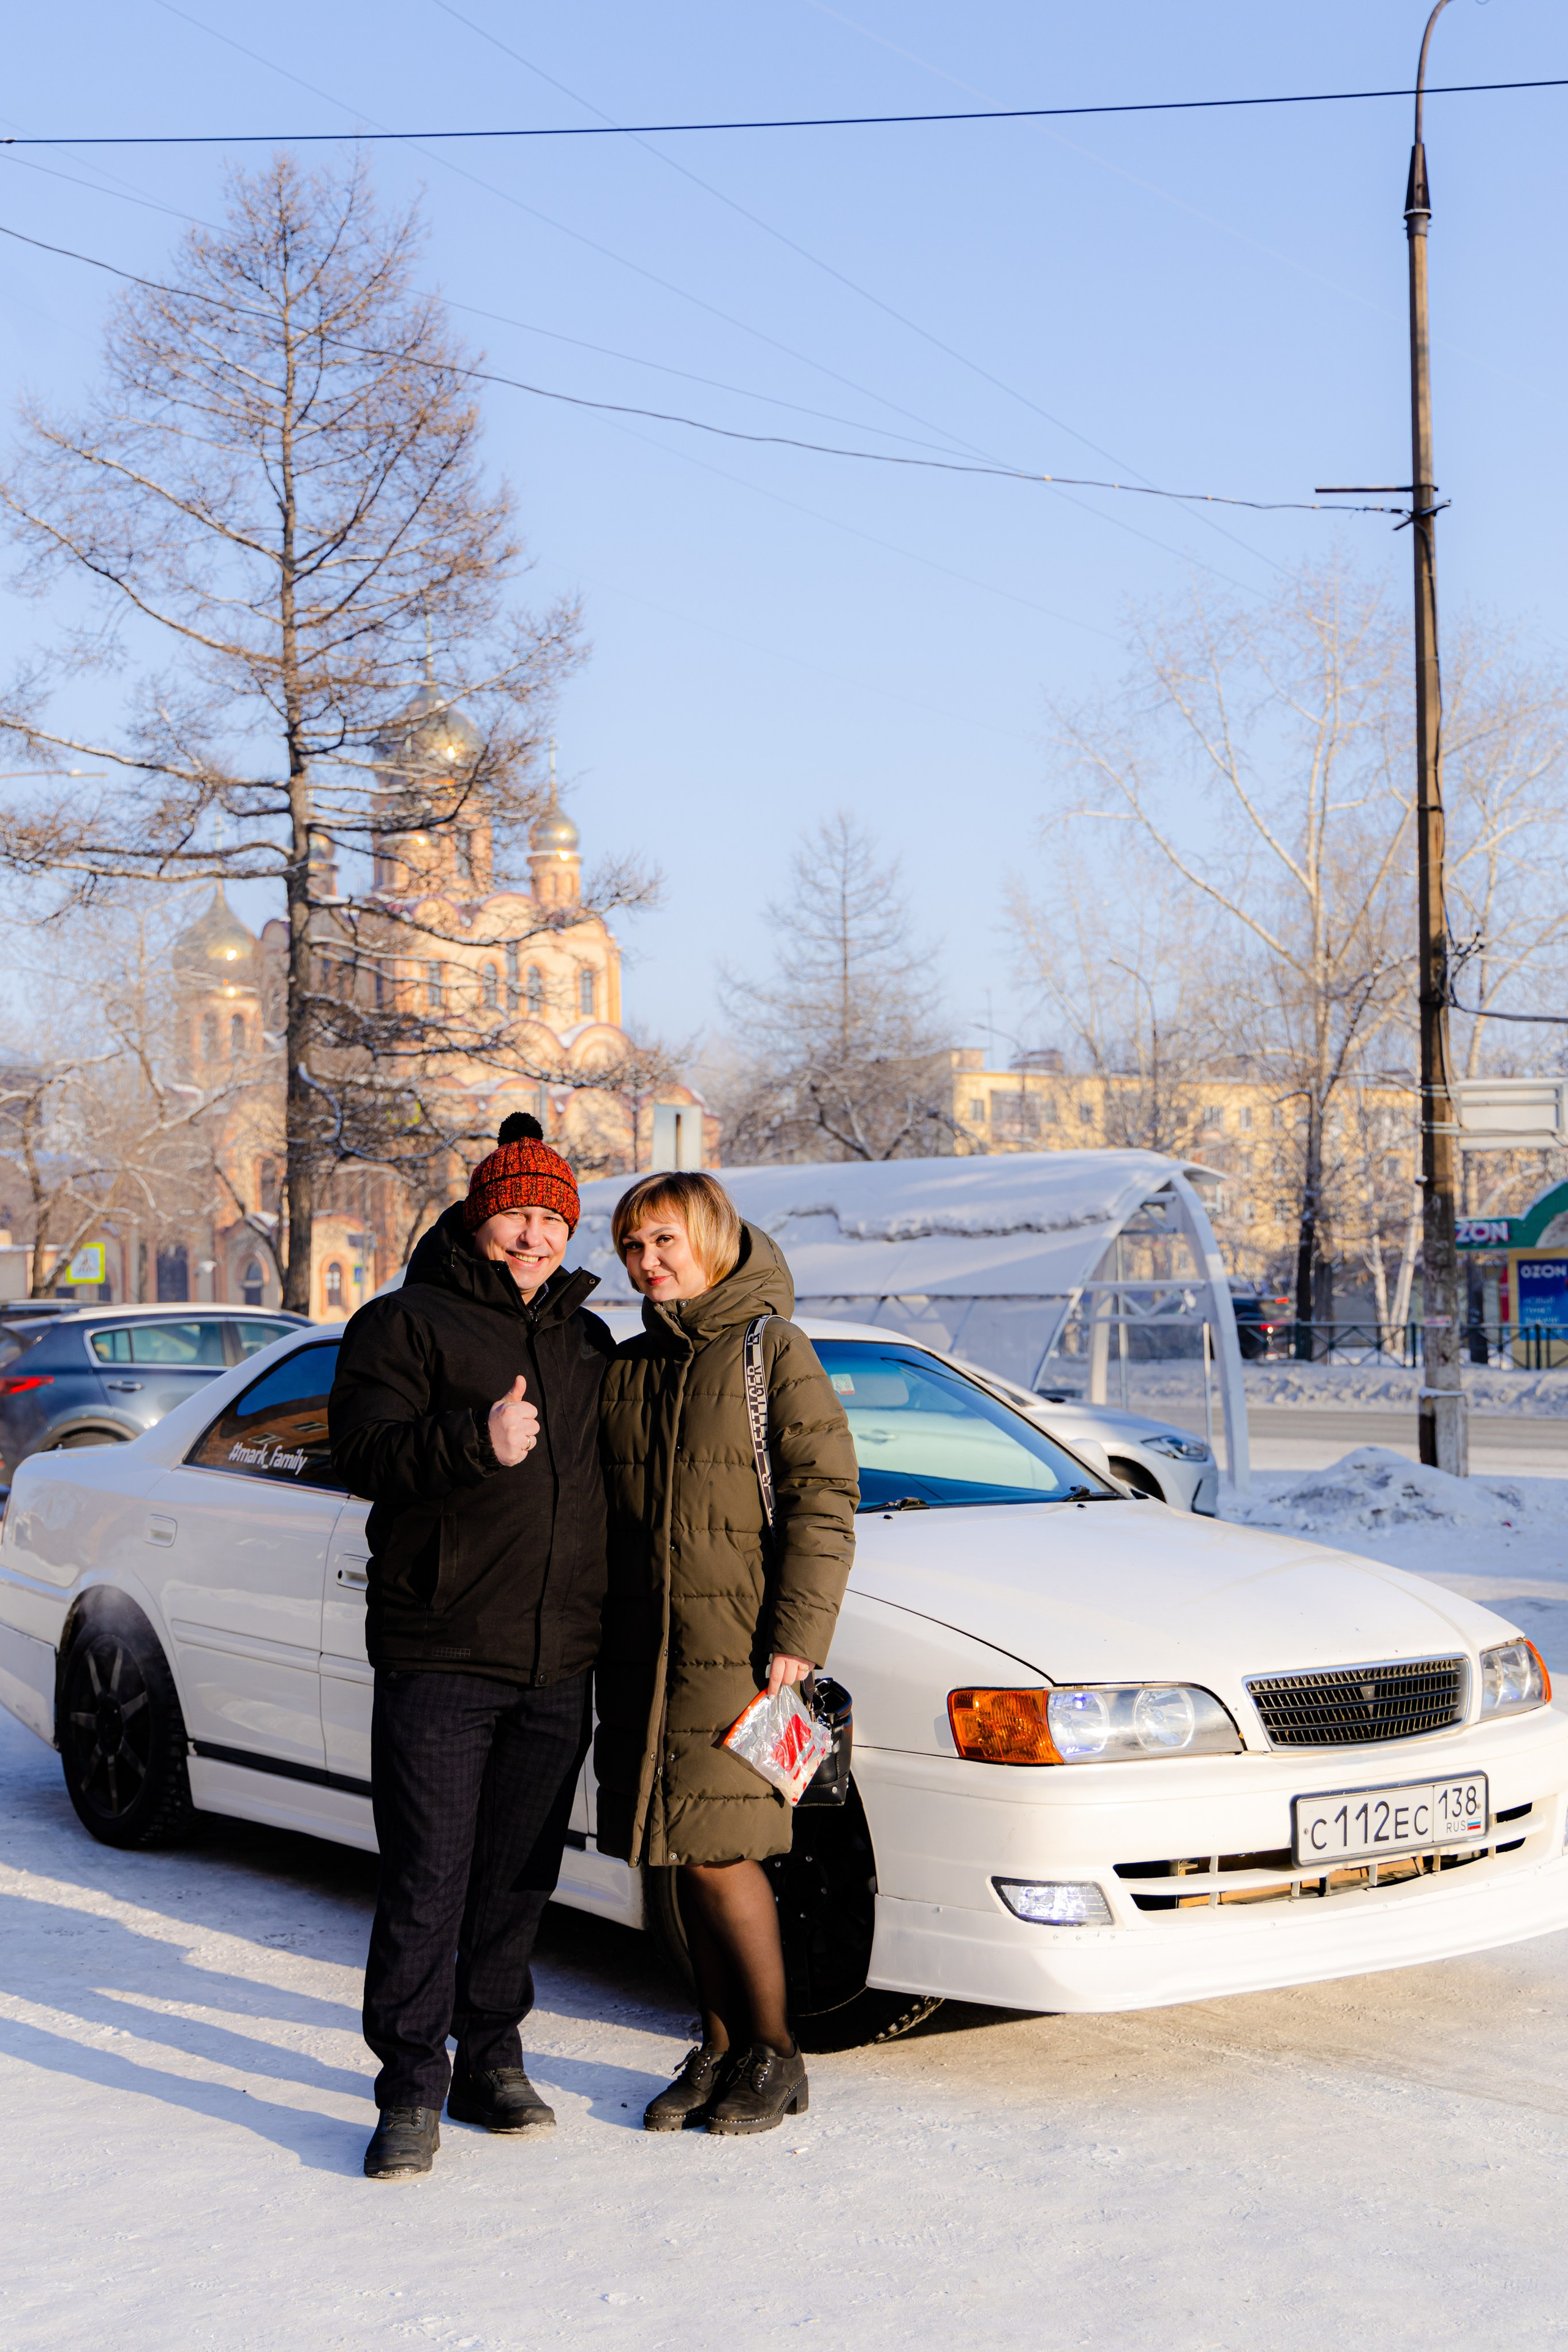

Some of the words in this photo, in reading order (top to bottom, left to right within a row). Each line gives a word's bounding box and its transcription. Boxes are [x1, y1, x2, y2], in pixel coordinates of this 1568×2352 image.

[1455, 1221, 1509, 1243] ZON
[1520, 1264, 1567, 1278] OZON
[228, 1442, 308, 1476] #mark_family
[1438, 1785, 1477, 1820] 138
[1446, 1820, 1466, 1834] RUS
